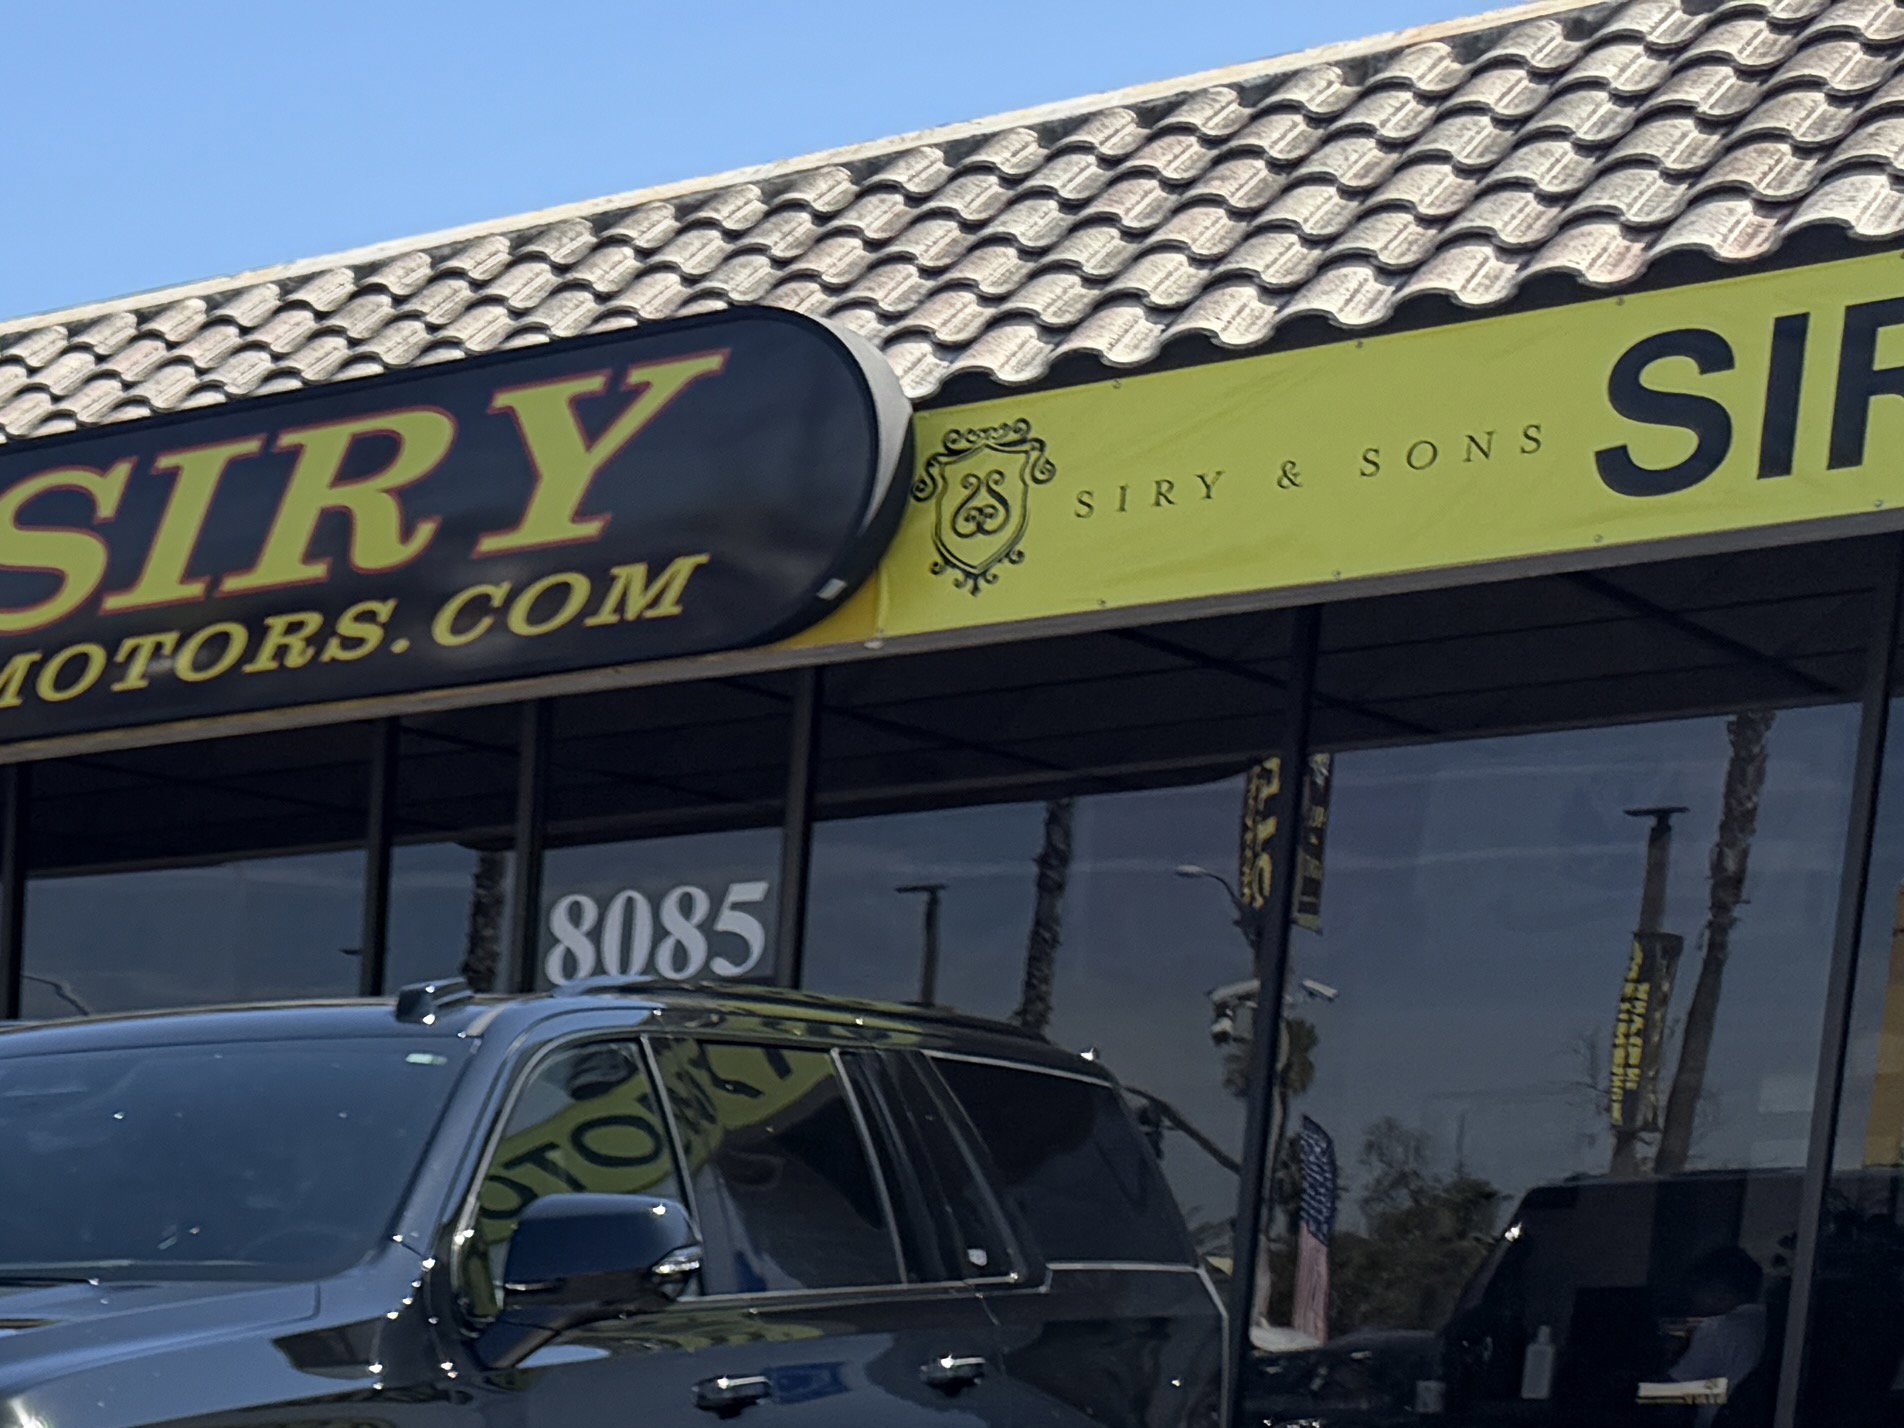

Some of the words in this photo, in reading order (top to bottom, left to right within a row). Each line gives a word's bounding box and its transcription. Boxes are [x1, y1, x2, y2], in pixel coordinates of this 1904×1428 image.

[1075, 469, 1226, 520] SIRY
[1276, 459, 1303, 490] &
[1359, 422, 1545, 478] SONS
[544, 880, 770, 986] 8085
